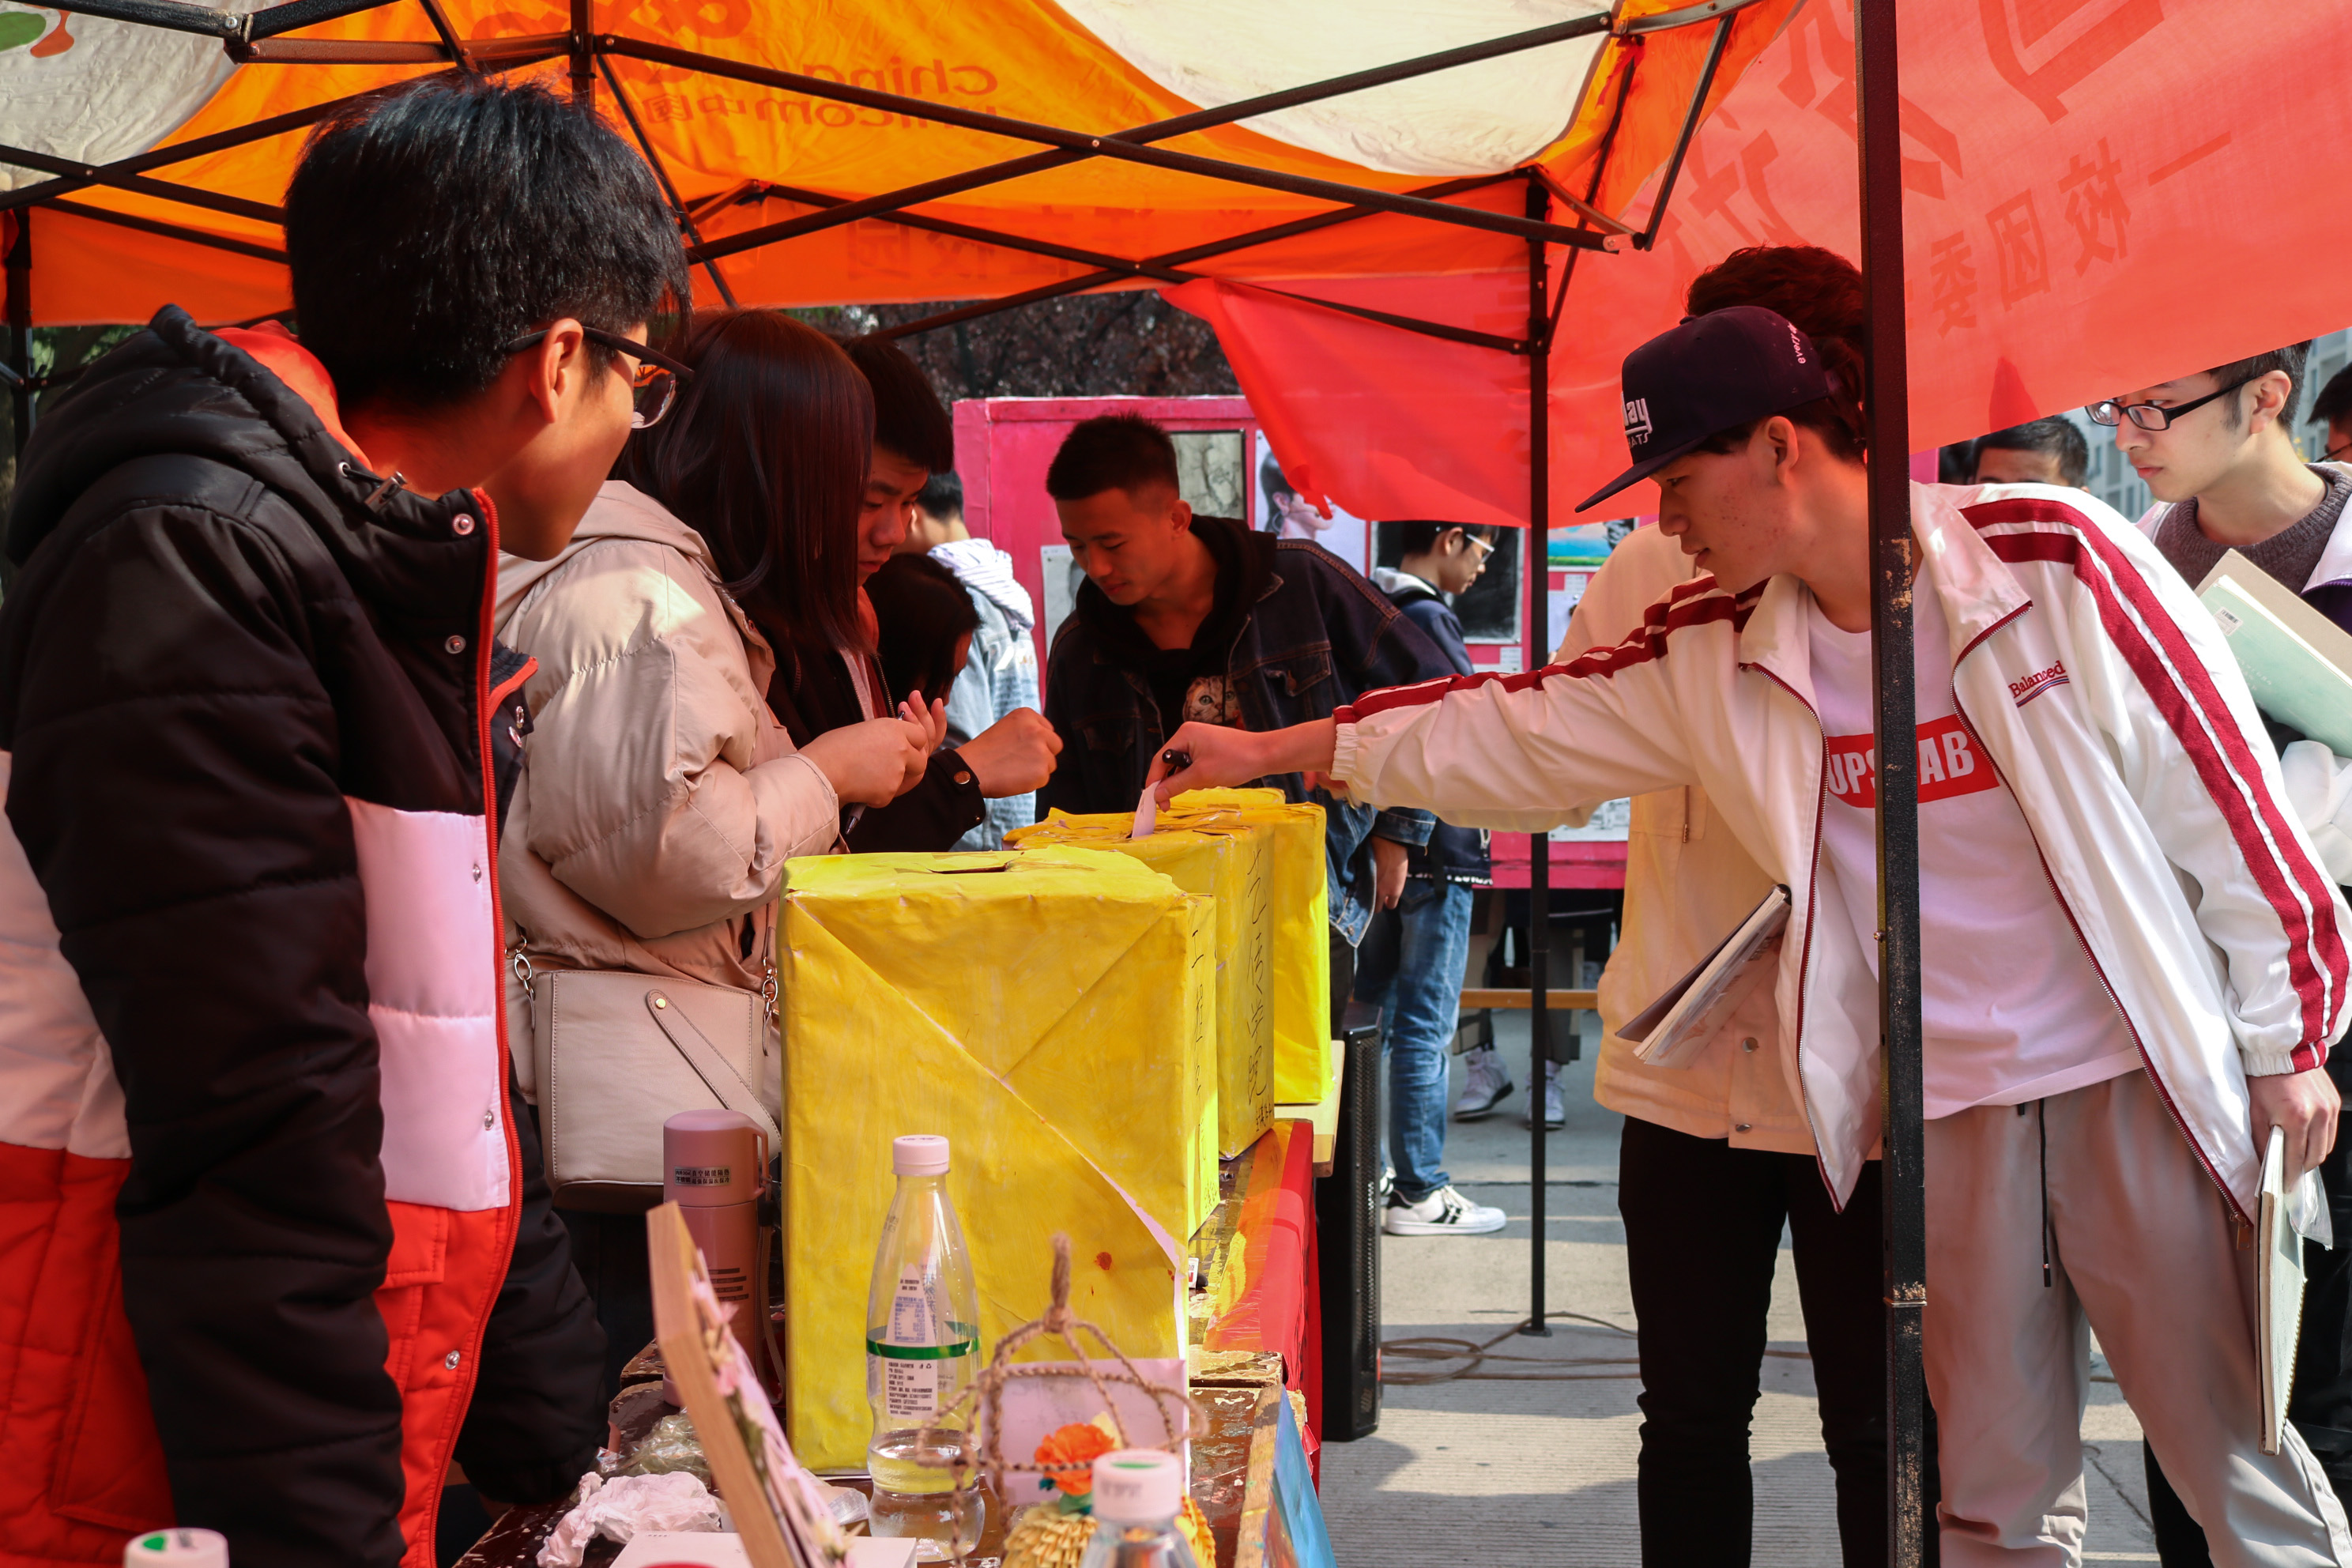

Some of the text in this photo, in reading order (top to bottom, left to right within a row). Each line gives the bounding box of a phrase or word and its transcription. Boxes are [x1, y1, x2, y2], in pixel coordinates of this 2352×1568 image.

[1628, 432, 1649, 449] ATS
[2007, 659, 2067, 699] Balanced
[1828, 730, 1975, 795] UPAB
